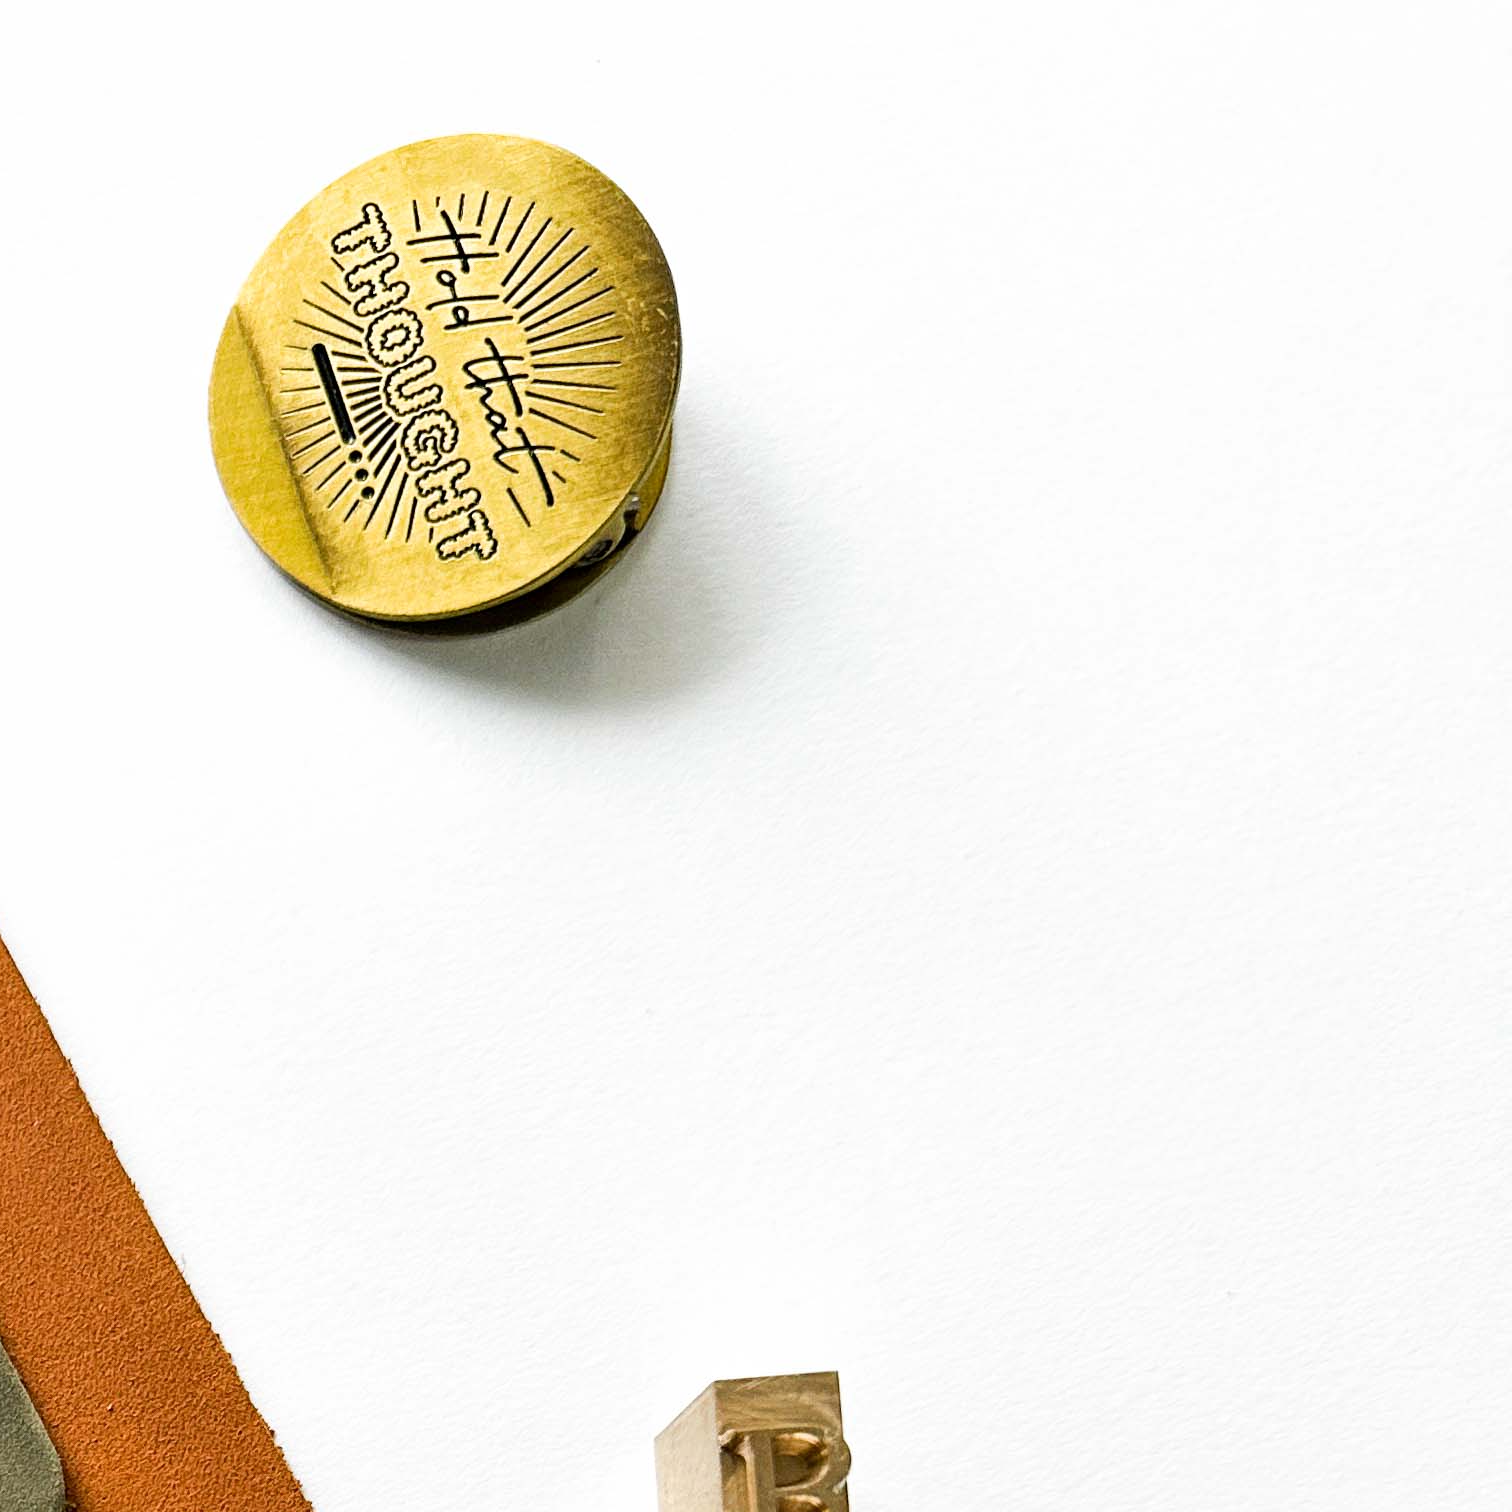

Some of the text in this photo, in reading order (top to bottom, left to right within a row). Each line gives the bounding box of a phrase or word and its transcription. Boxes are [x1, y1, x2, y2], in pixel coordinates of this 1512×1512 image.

[331, 202, 498, 561] THOUGHT
[406, 210, 556, 506] Hold that
